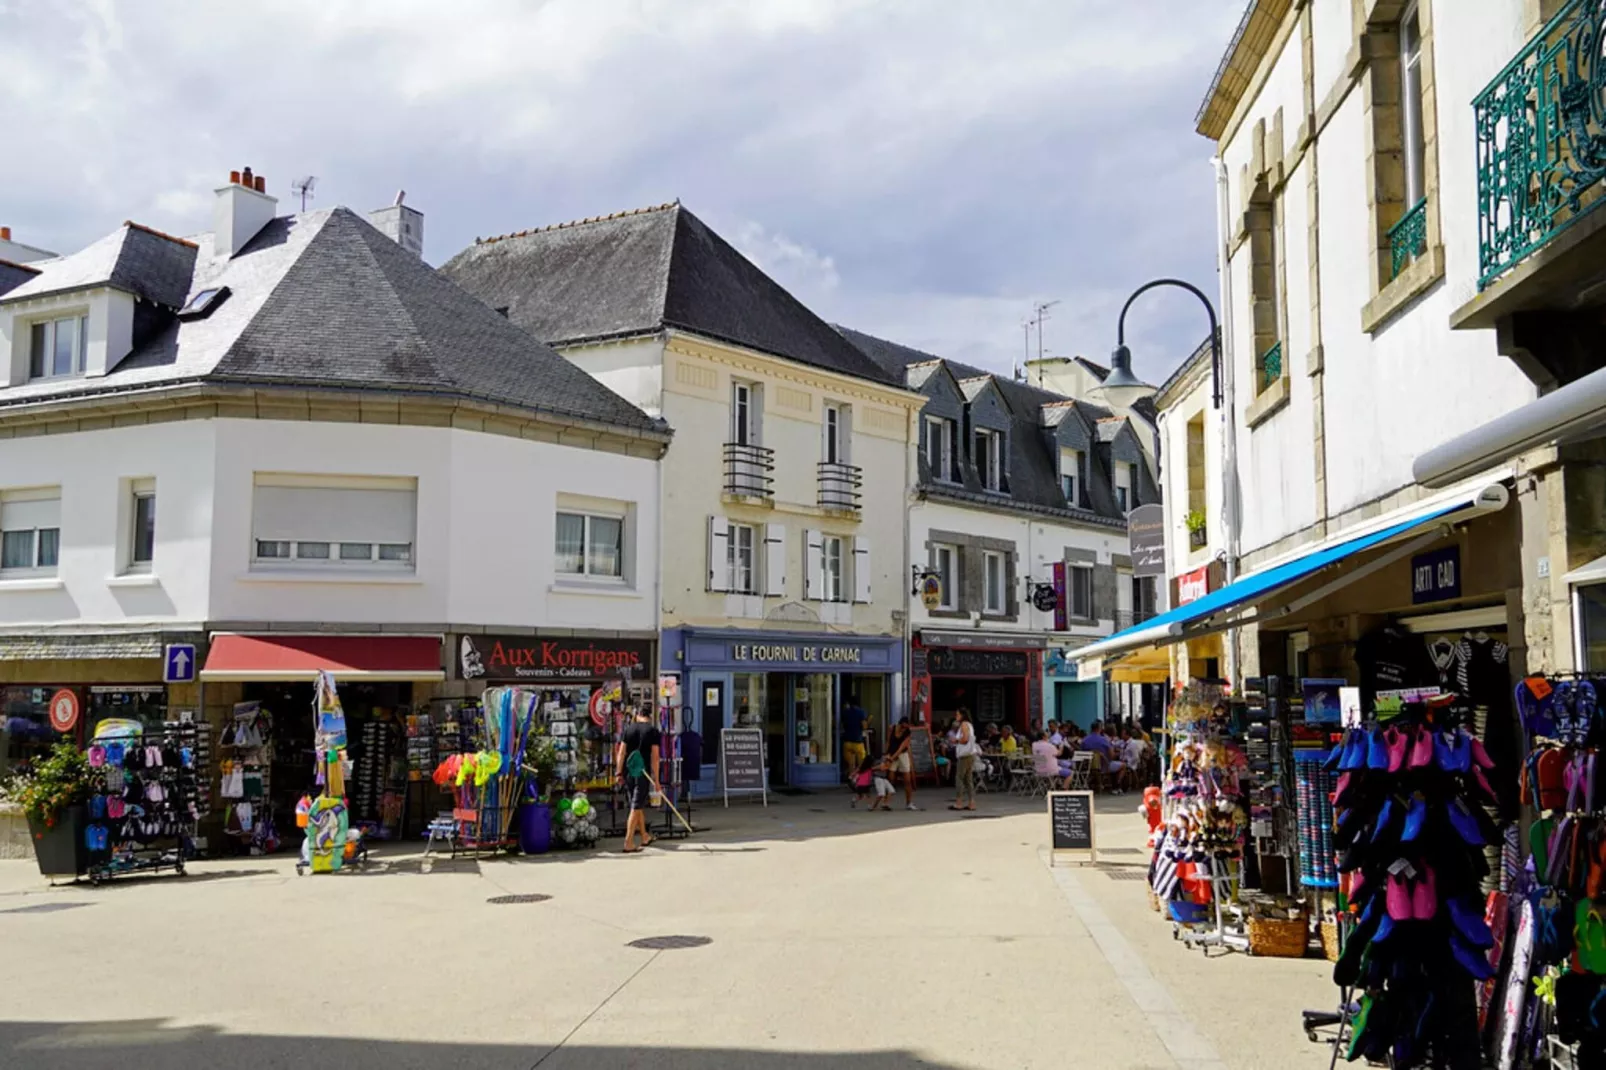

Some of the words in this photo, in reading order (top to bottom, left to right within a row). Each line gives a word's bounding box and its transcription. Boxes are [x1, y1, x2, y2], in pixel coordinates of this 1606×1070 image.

[1415, 565, 1432, 592] ARTI
[490, 641, 534, 666] Aux
[541, 642, 640, 675] Korrigans
[735, 645, 747, 660] LE
[752, 645, 798, 661] FOURNIL
[803, 647, 816, 661] DE
[821, 647, 860, 662] CARNAC
[515, 667, 553, 677] Souvenirs
[559, 667, 591, 677] Cadeaux
